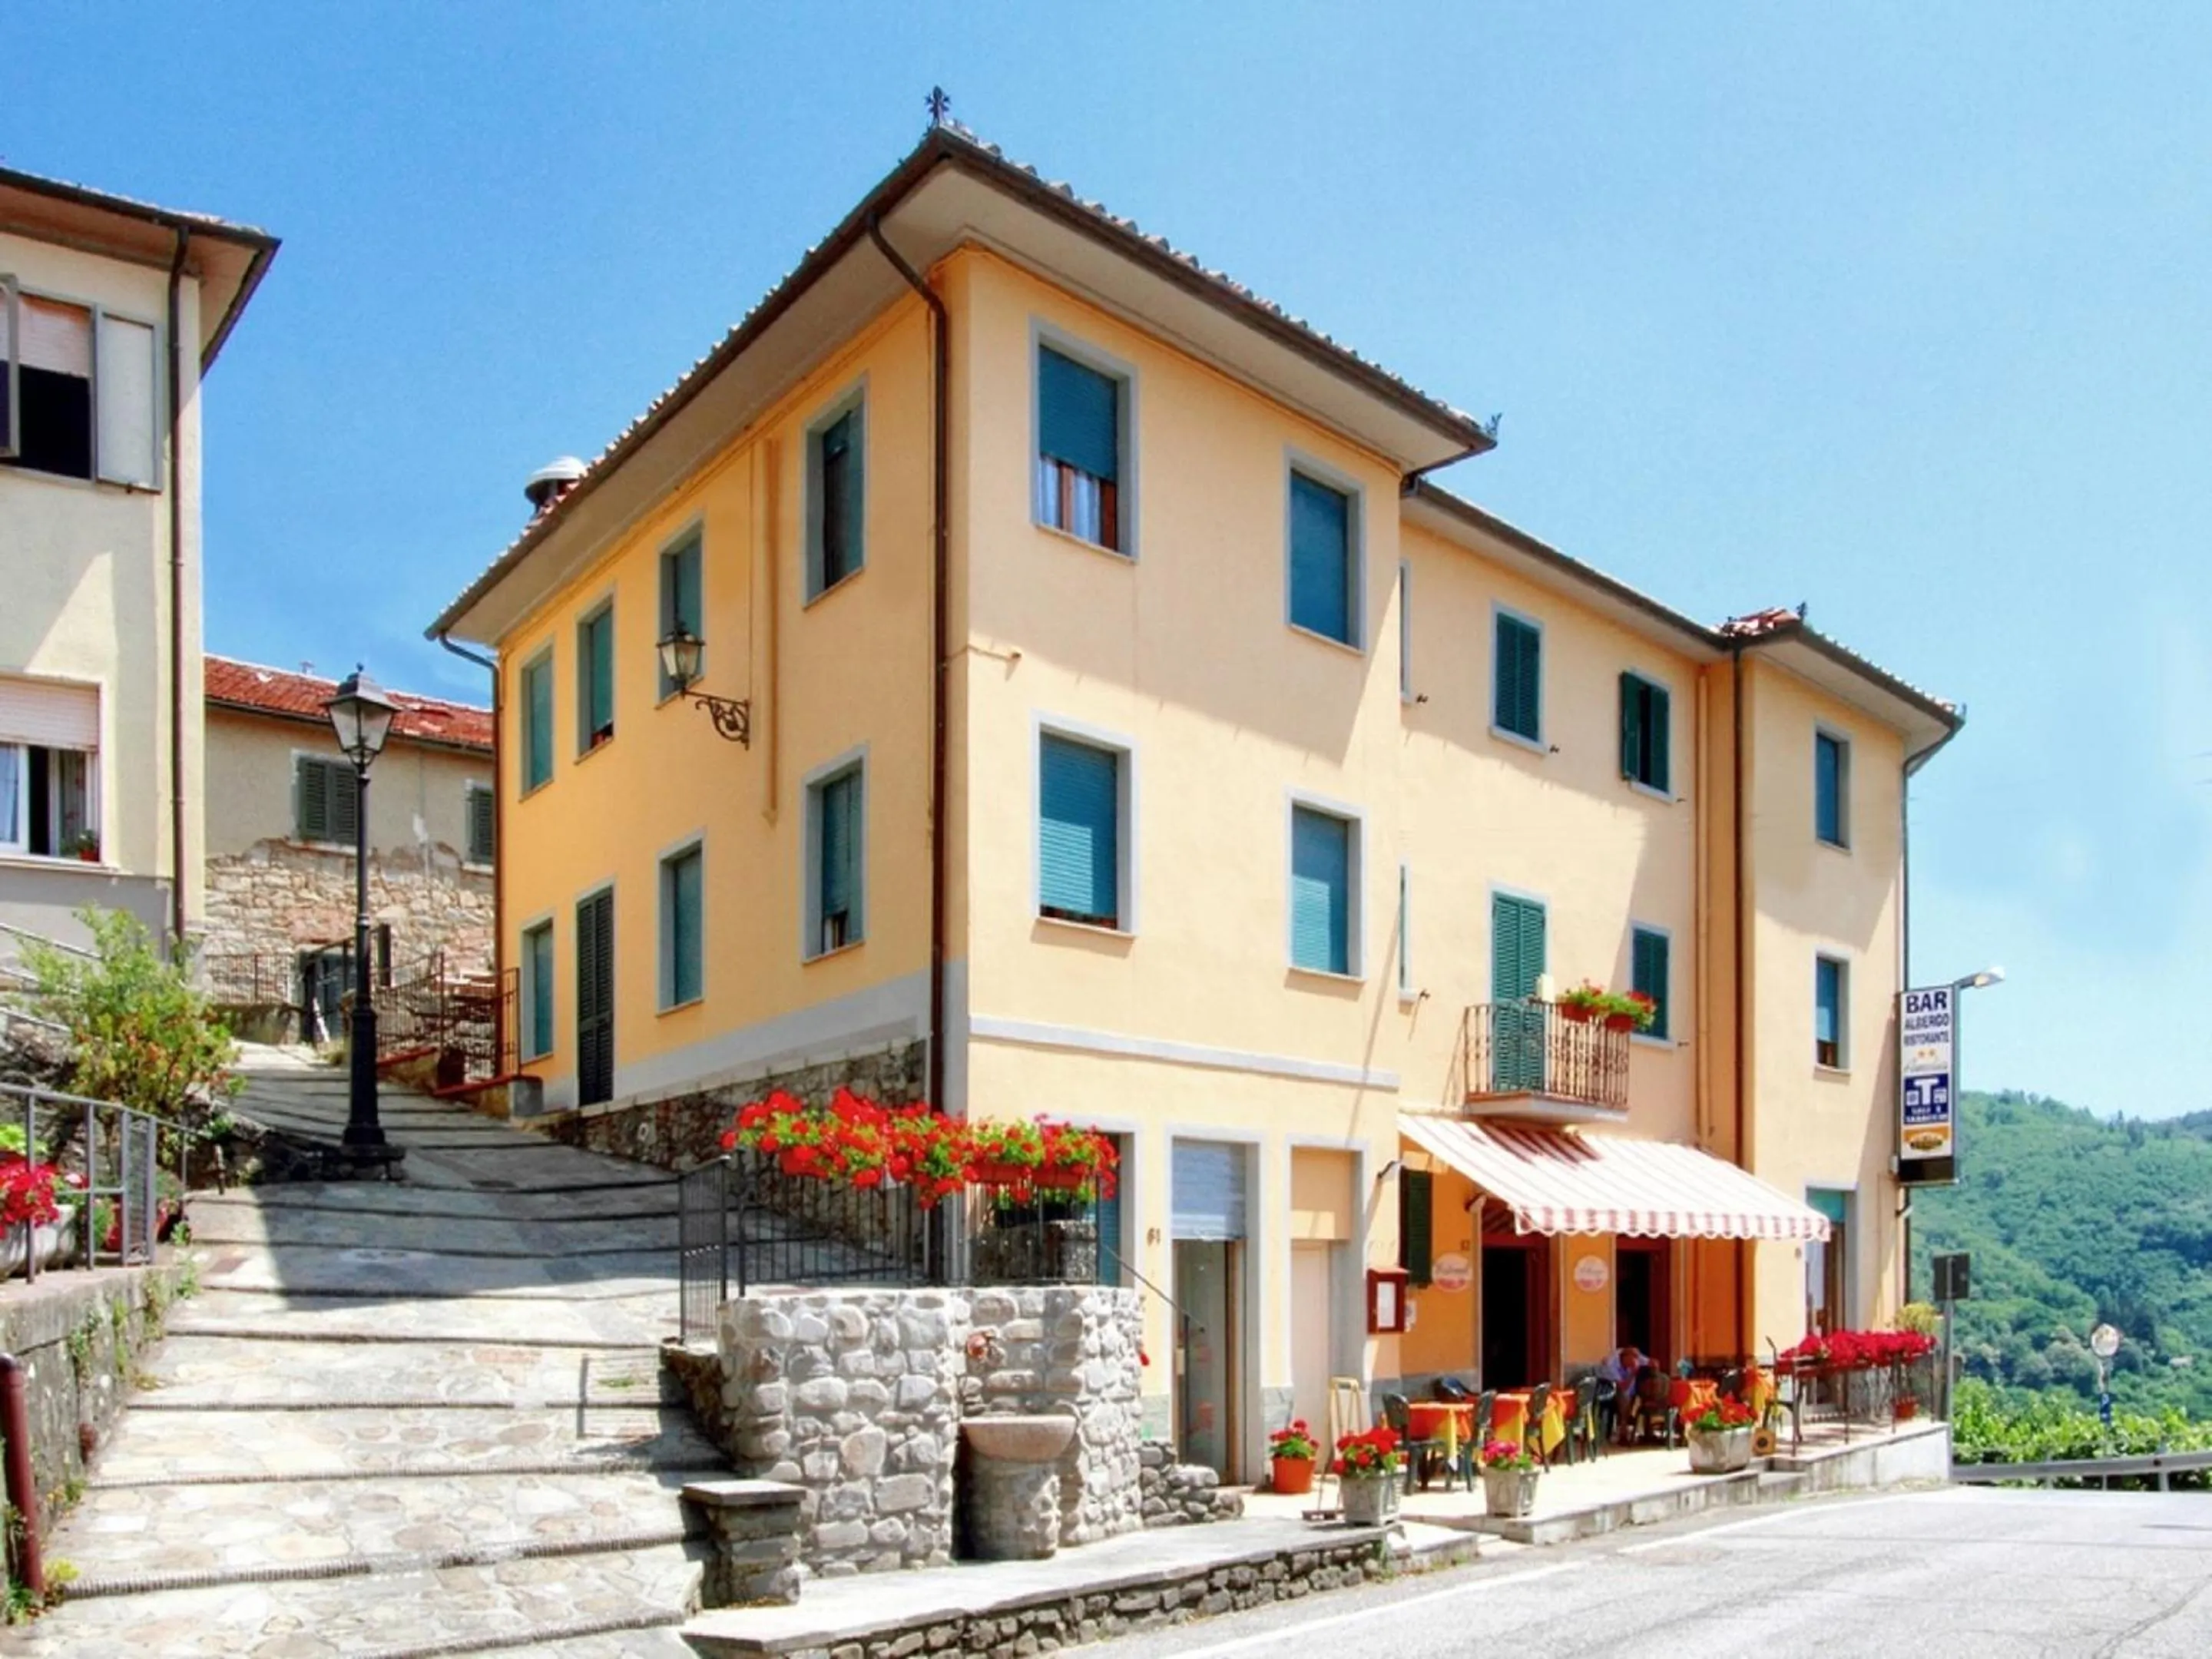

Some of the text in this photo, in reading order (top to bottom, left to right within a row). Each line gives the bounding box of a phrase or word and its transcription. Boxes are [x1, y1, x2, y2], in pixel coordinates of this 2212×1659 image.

[1906, 991, 1947, 1013] BAR
[1904, 1013, 1949, 1030] ALBERGO
[1904, 1031, 1949, 1046] RISTORANTE
[1914, 1078, 1939, 1105] T
